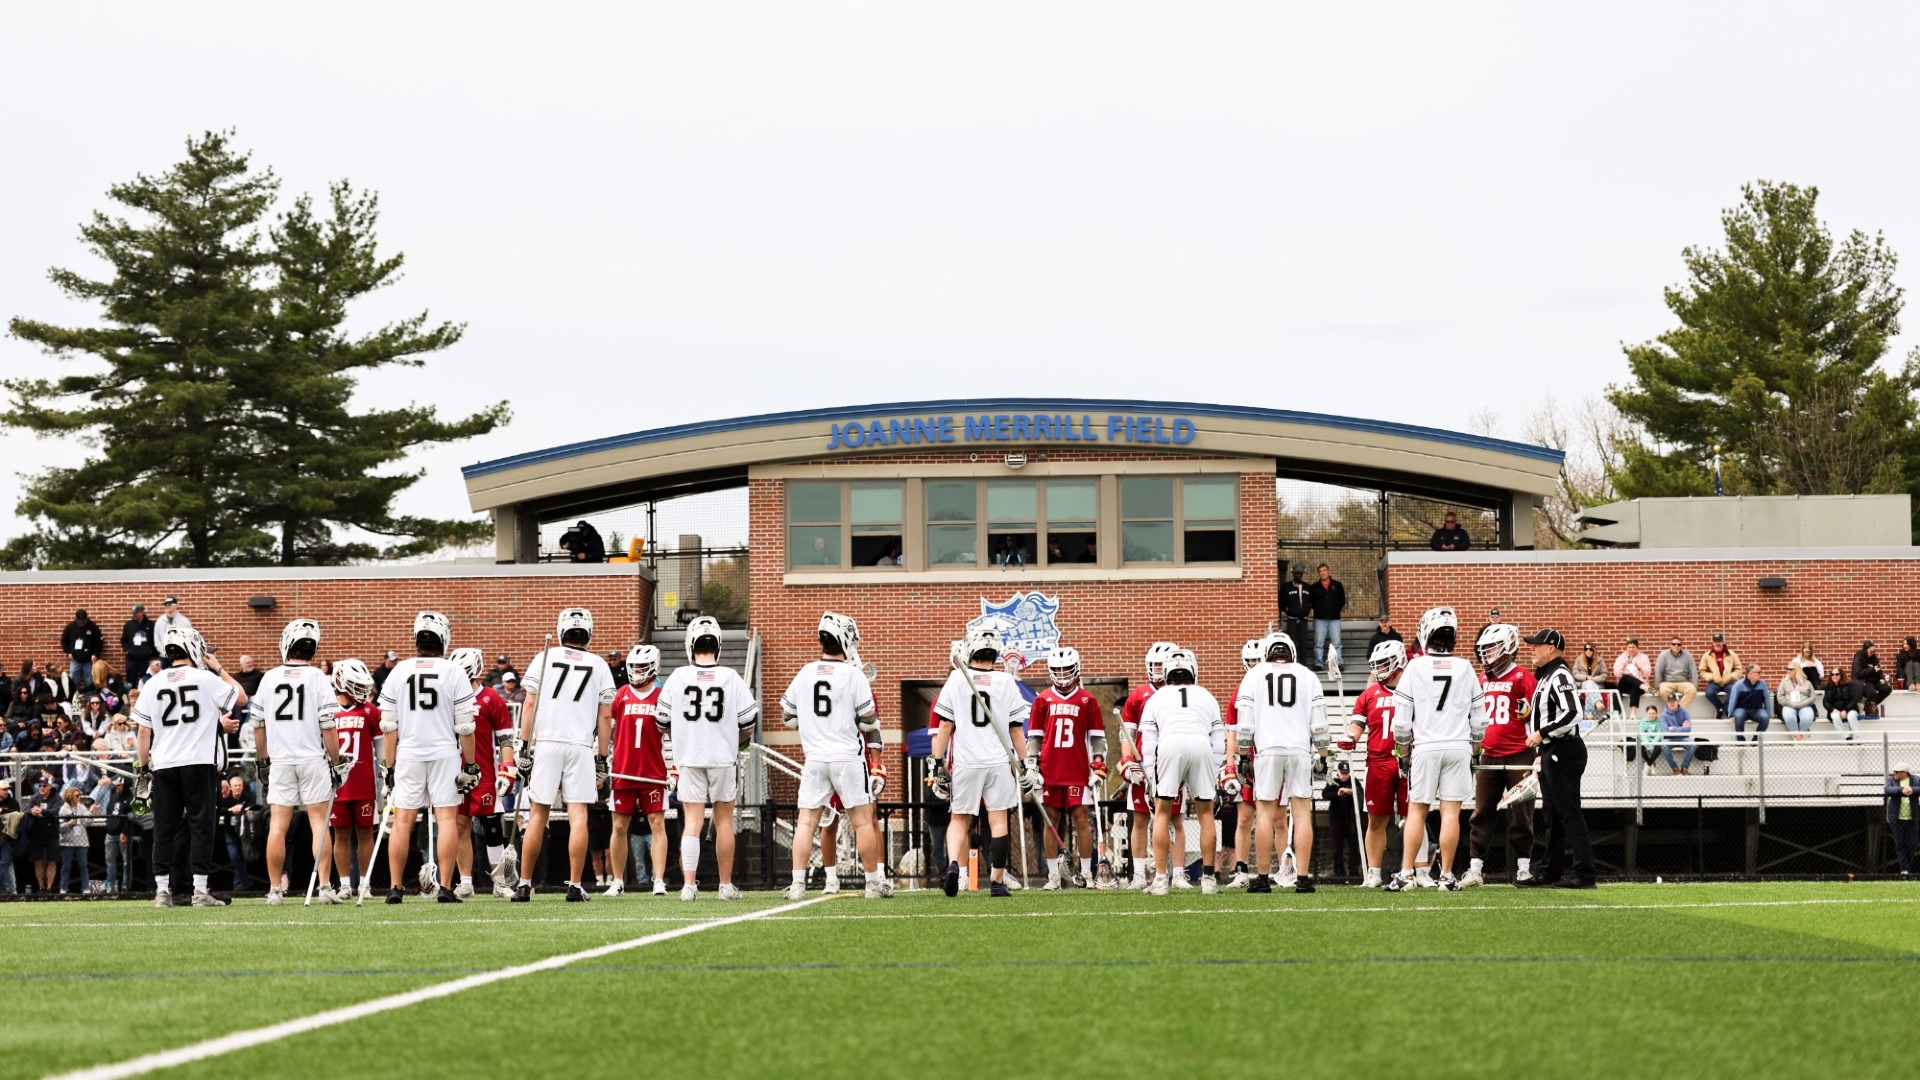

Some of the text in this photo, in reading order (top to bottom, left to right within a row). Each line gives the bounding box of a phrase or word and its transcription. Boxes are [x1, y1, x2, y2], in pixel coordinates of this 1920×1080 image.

[827, 414, 1195, 450] JOANNE MERRILL FIELD
[406, 673, 439, 711] 15
[551, 662, 593, 702] 77
[813, 680, 832, 718] 6
[1178, 687, 1188, 708] 1
[1265, 672, 1297, 708] 10
[1432, 675, 1453, 712] 7
[156, 684, 200, 727] 25
[274, 683, 305, 721] 21
[624, 703, 656, 716] REGIS
[683, 685, 725, 723] 33
[970, 690, 991, 728] 0
[1050, 703, 1080, 717] REGIS
[1485, 695, 1510, 725] 28
[338, 731, 360, 761] 21
[634, 717, 644, 749] 1
[1054, 717, 1075, 748] 13
